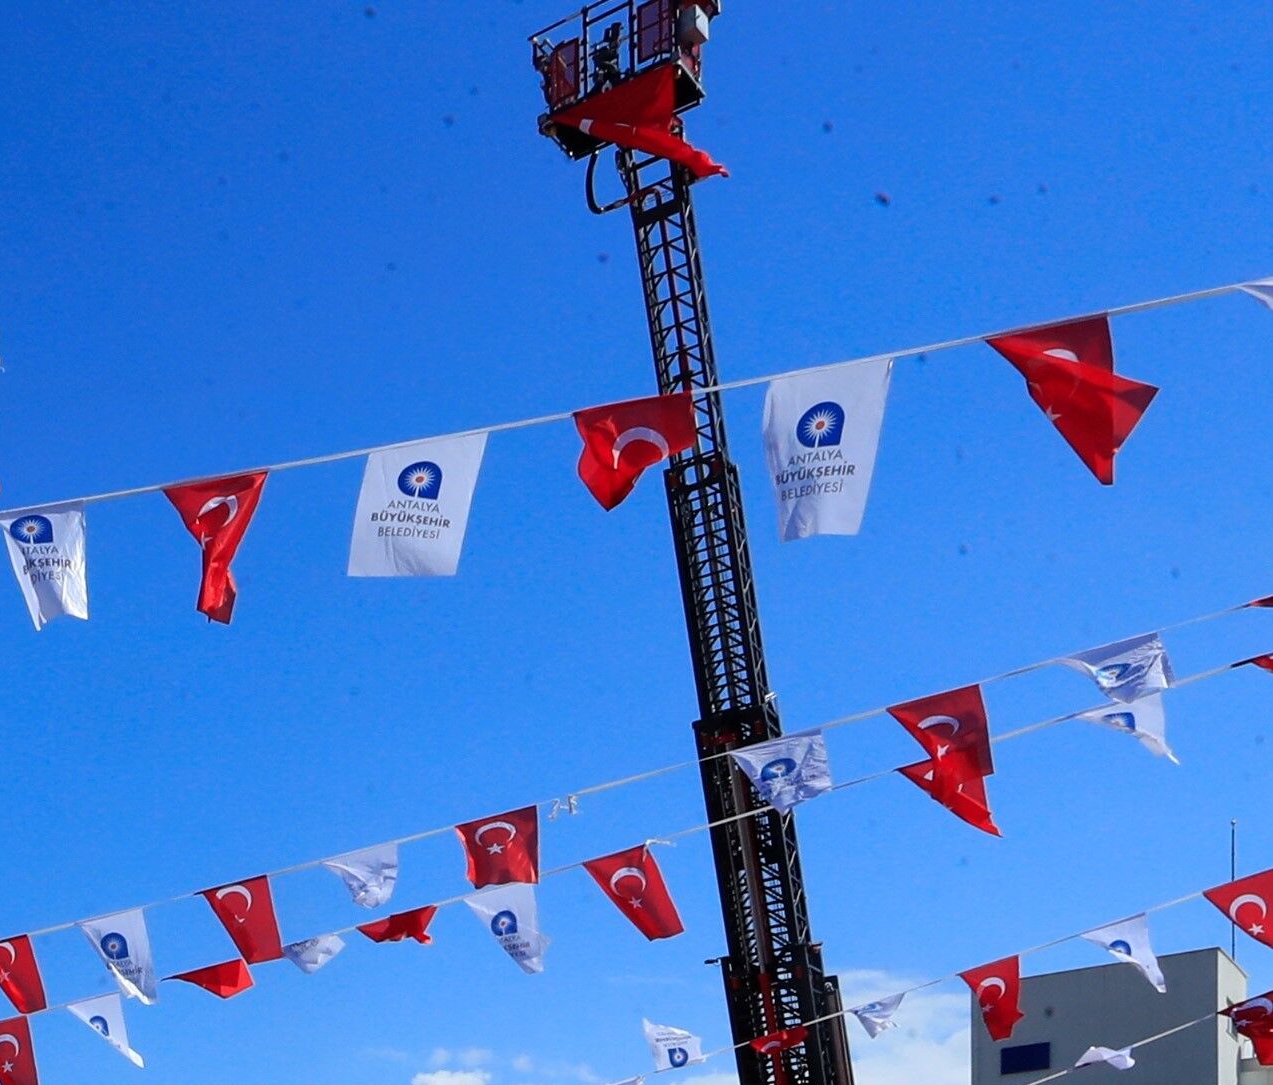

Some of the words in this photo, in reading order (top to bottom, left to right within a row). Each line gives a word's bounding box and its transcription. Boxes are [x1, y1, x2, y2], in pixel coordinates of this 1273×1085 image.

[788, 451, 842, 467] ANTALYA
[776, 462, 855, 486] BÜYÜKŞEHİR
[781, 482, 842, 501] BELEDİYESİ
[388, 499, 440, 514] ANTALYA
[371, 511, 450, 529] BÜYÜKŞEHİR
[378, 525, 440, 540] BELEDİYESİ
